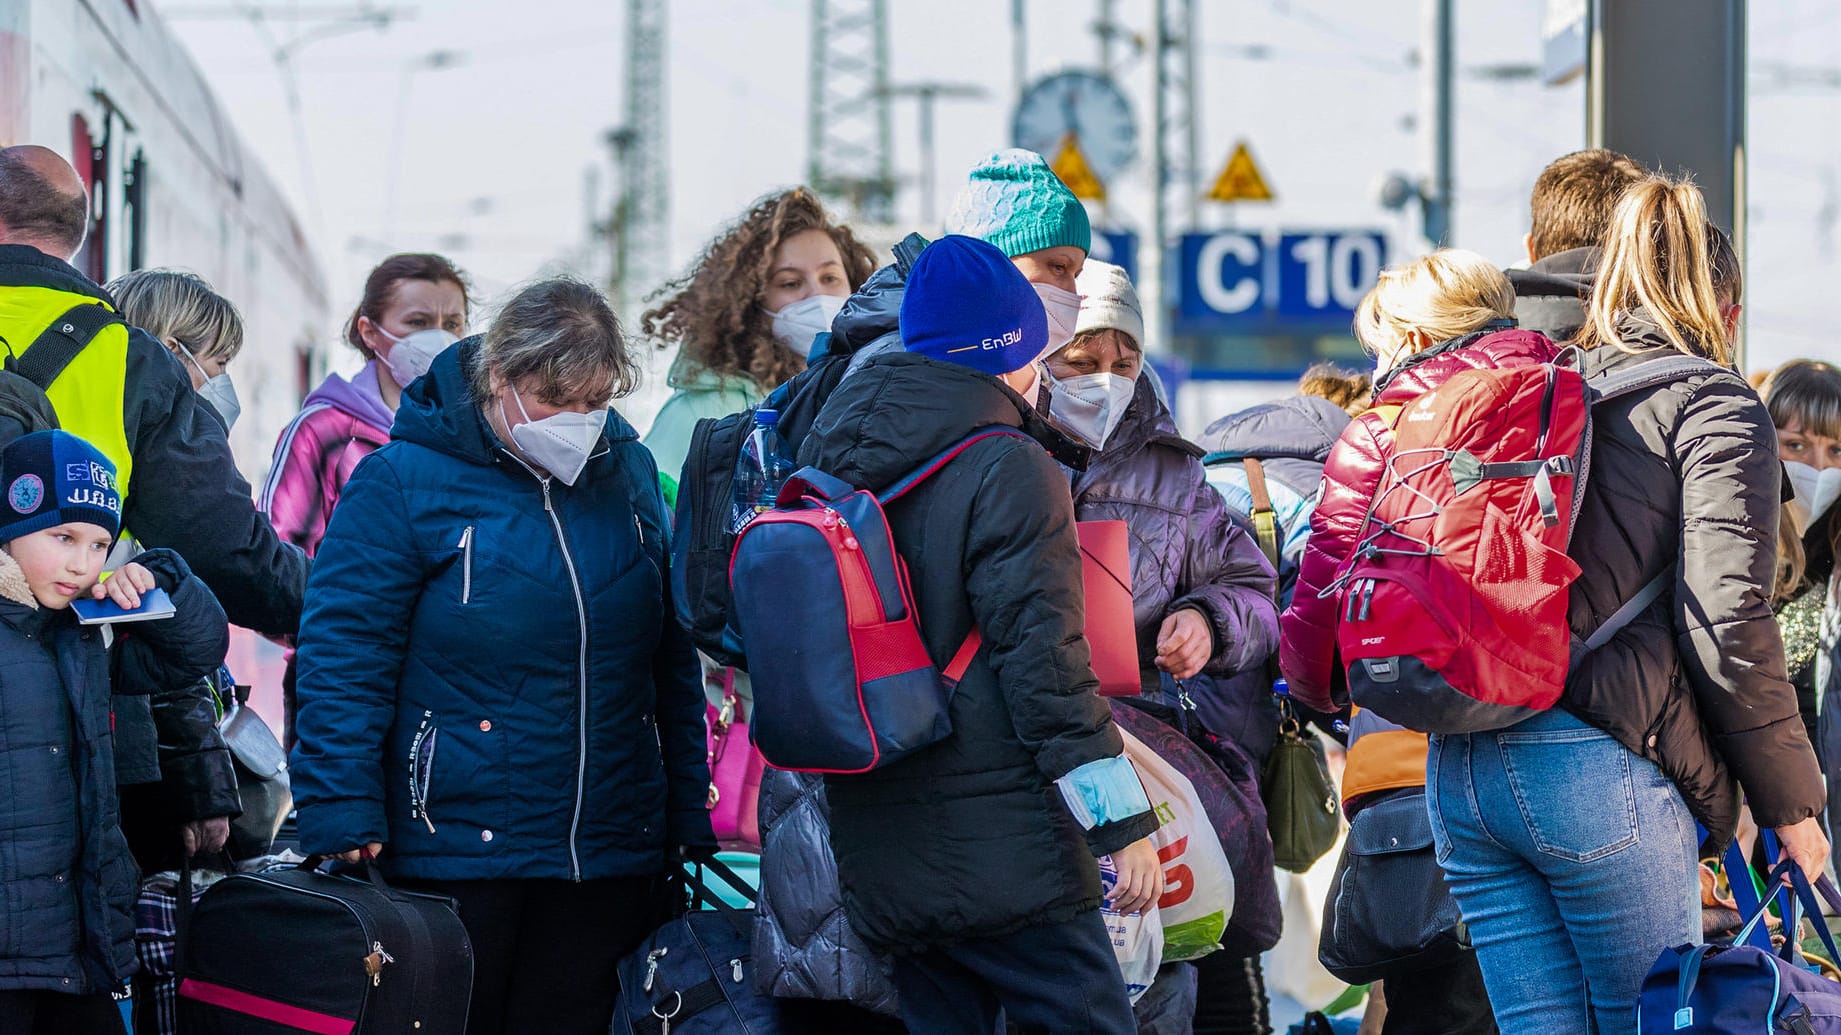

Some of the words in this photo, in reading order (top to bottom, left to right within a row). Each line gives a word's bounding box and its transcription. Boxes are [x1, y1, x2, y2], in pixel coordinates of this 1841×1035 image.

[1197, 234, 1260, 314] C
[1290, 236, 1381, 311] 10
[982, 327, 1022, 350] EnBW
